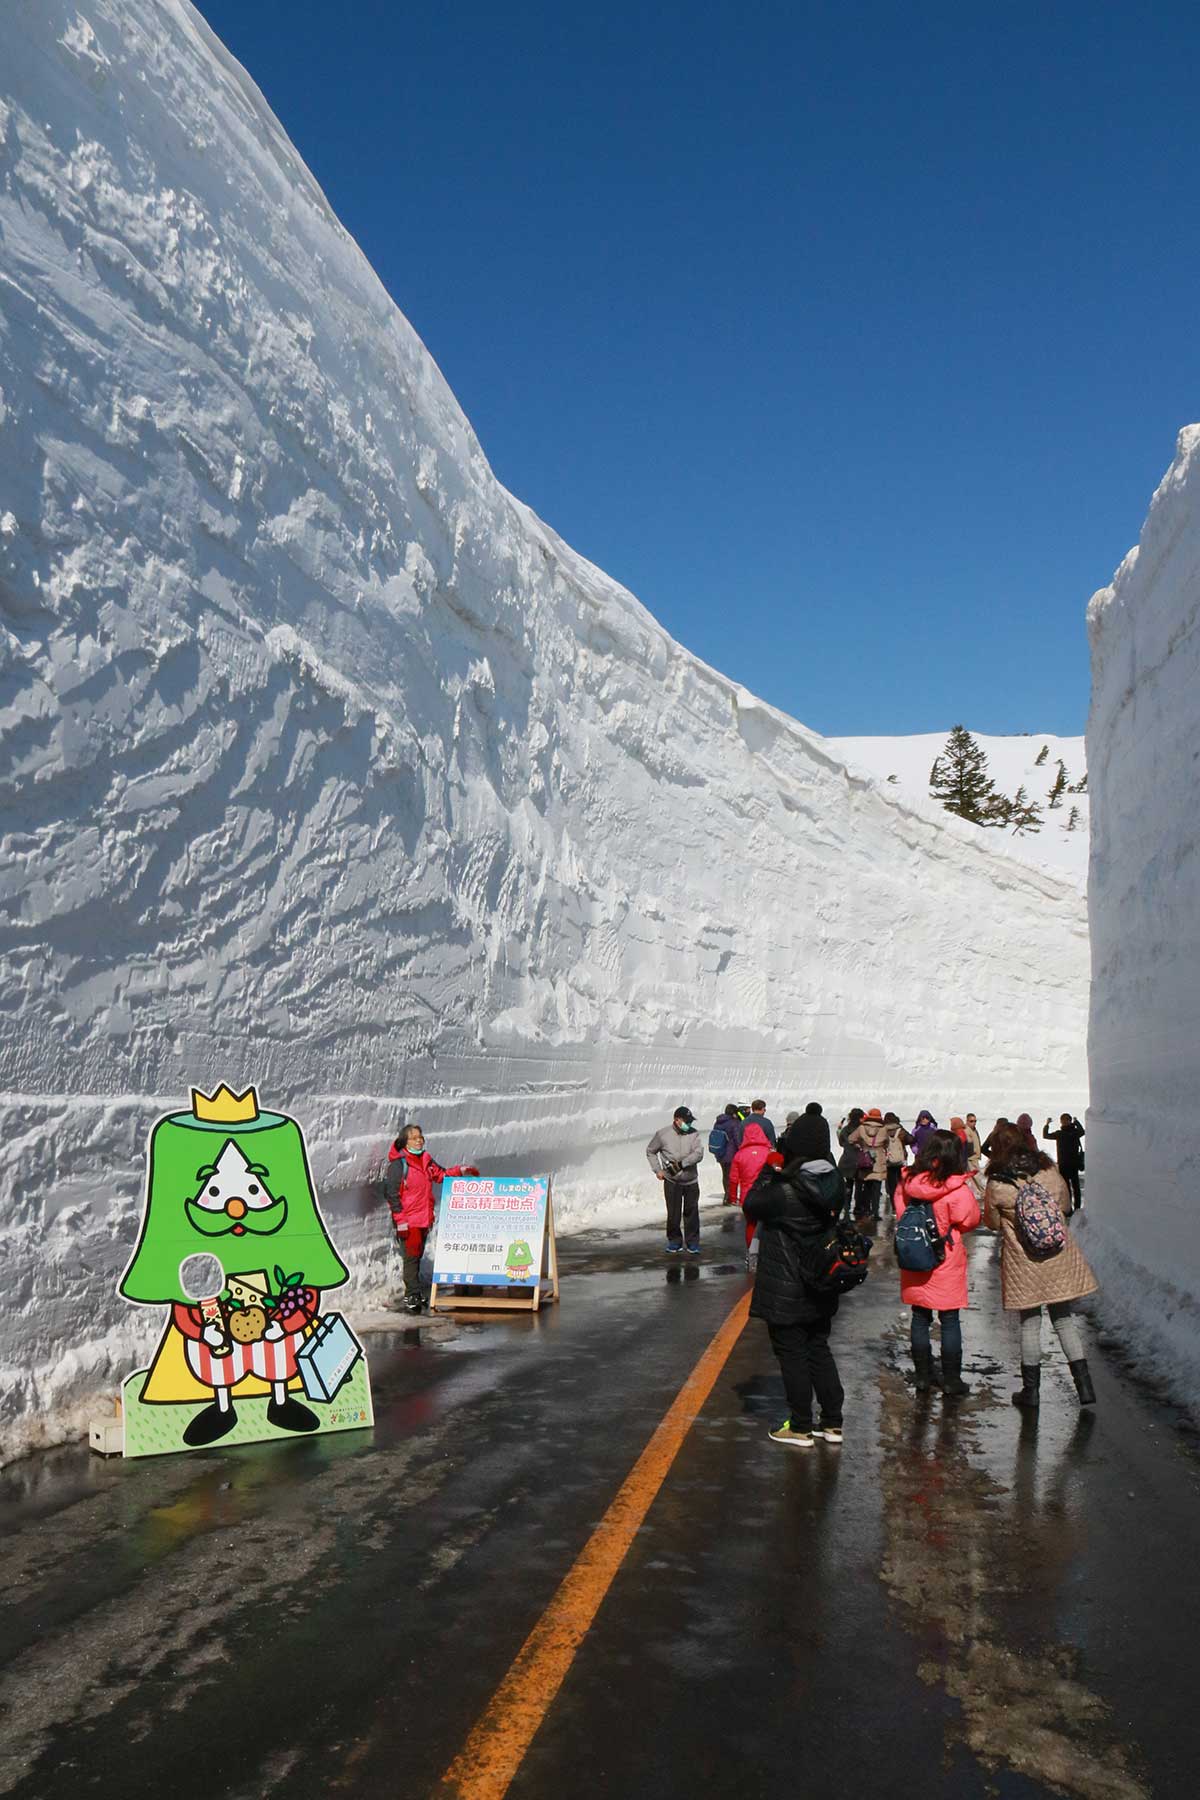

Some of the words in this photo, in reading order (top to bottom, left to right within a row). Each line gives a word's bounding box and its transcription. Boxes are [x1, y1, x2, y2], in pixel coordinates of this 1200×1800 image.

[450, 1197, 535, 1210] 最高積雪地点
[444, 1243, 503, 1253] 今年の積雪量は
